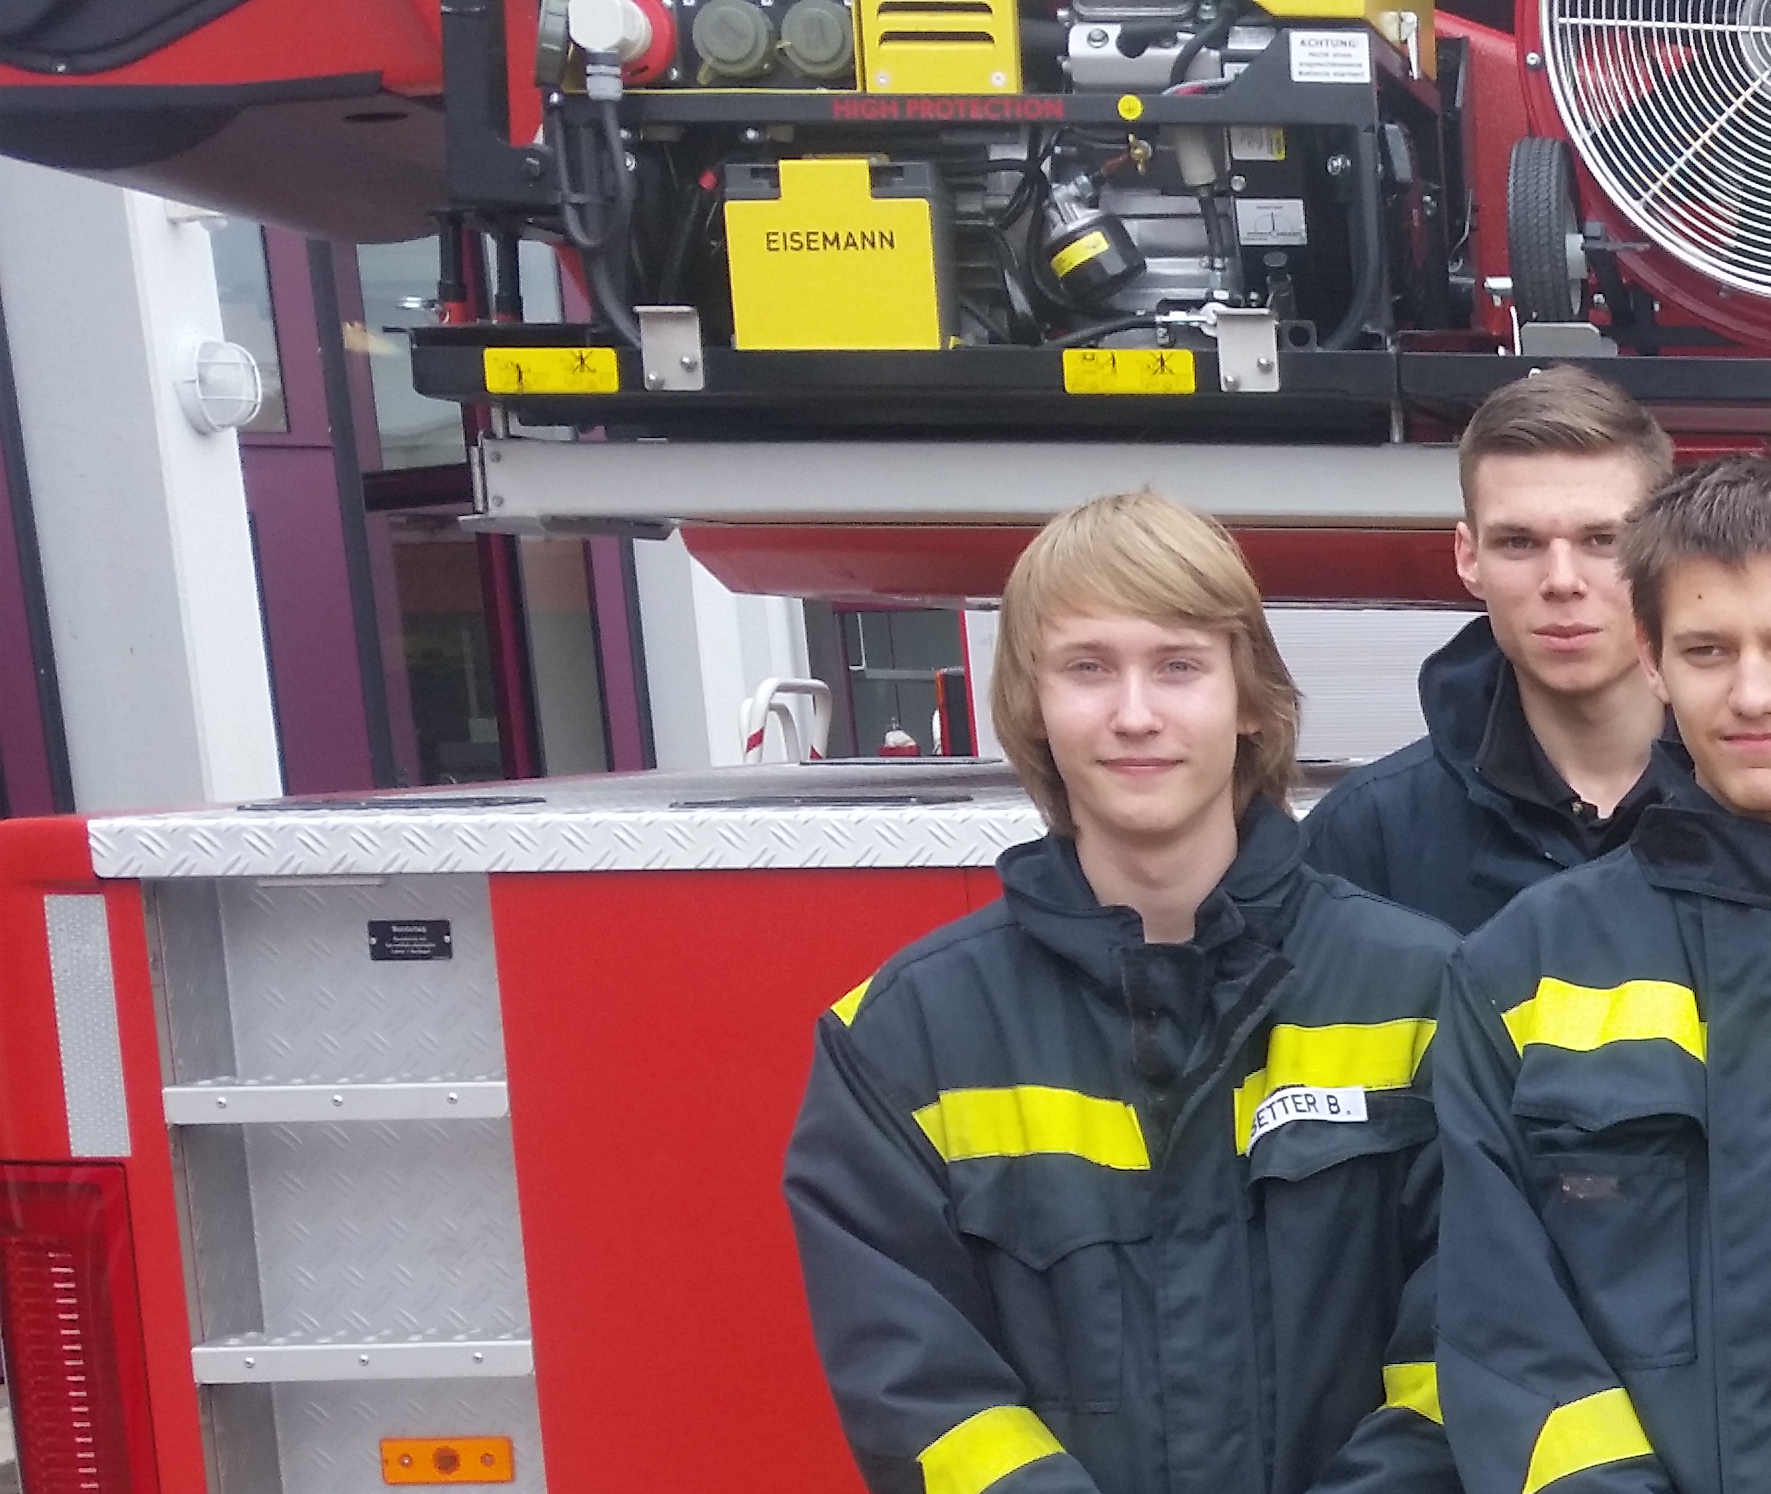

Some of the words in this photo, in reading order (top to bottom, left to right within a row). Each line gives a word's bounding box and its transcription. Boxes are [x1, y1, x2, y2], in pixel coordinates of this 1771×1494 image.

[832, 98, 899, 119] HIGH
[905, 98, 1064, 119] PROTECTION
[766, 230, 895, 251] EISEMANN
[1326, 1094, 1352, 1116] B.
